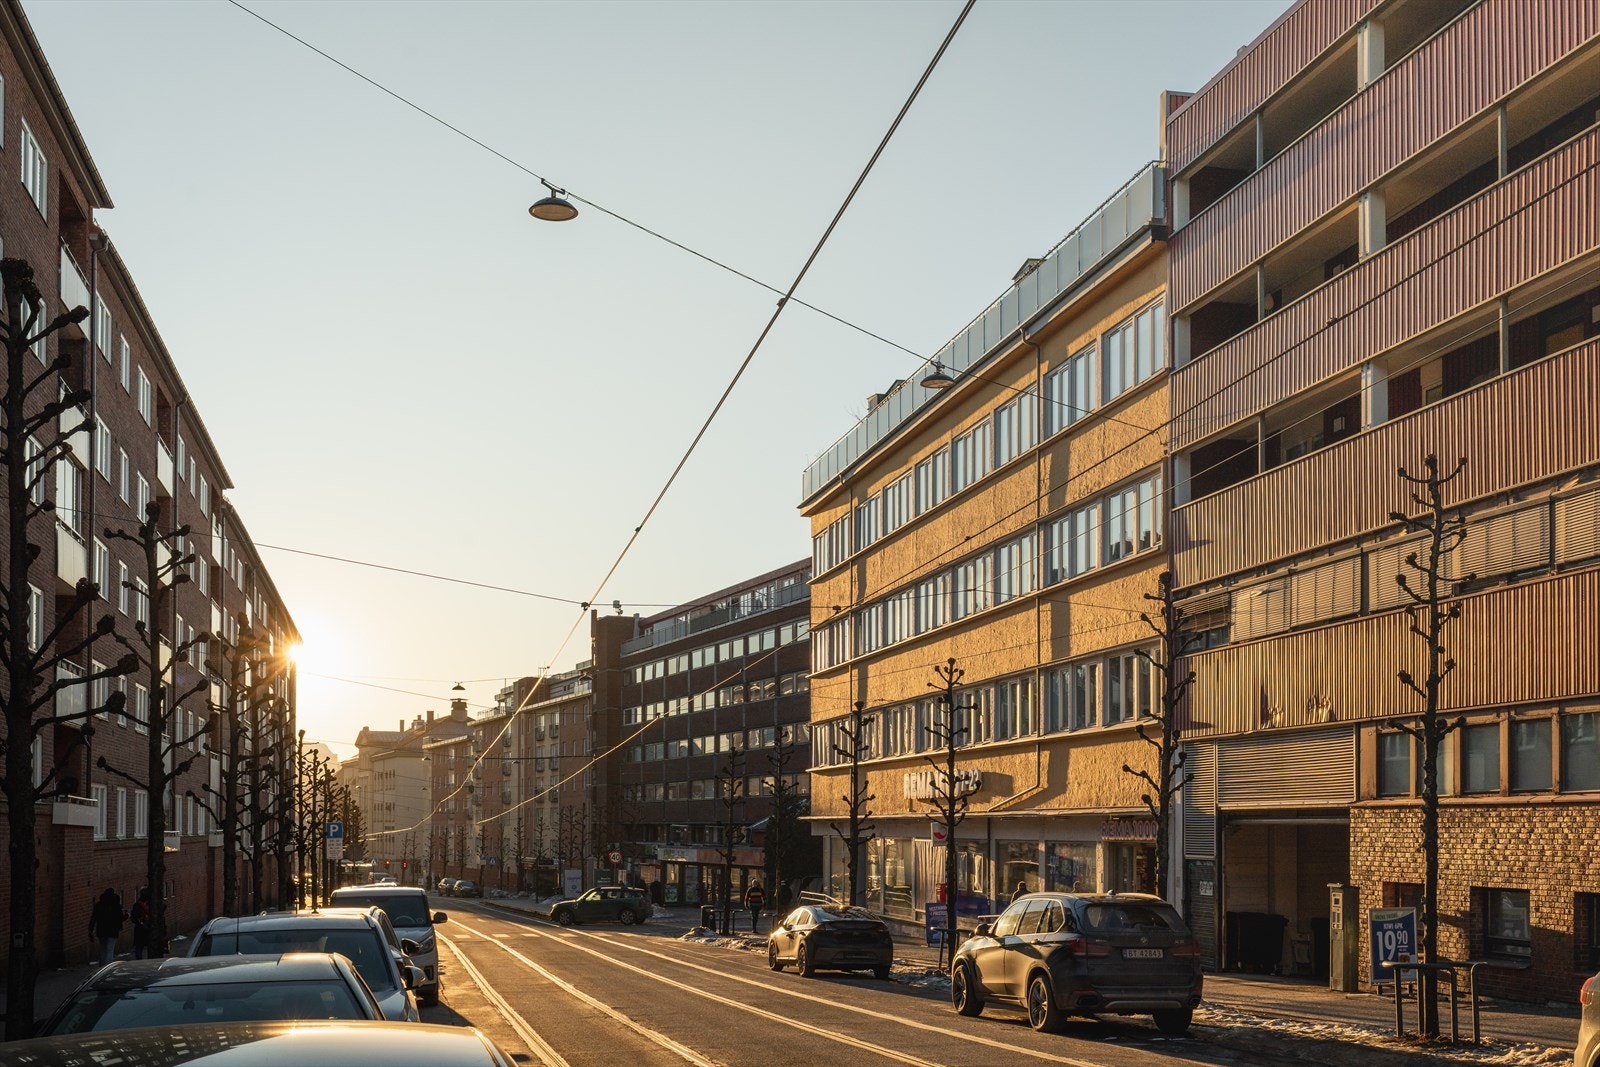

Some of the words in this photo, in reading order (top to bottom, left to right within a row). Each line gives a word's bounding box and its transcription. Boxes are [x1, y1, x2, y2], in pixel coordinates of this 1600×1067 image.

[904, 771, 933, 800] REMA
[330, 824, 339, 837] P
[1101, 820, 1131, 839] REMA
[1132, 820, 1158, 838] 1000
[1376, 930, 1396, 961] 19
[1397, 930, 1408, 945] 90
